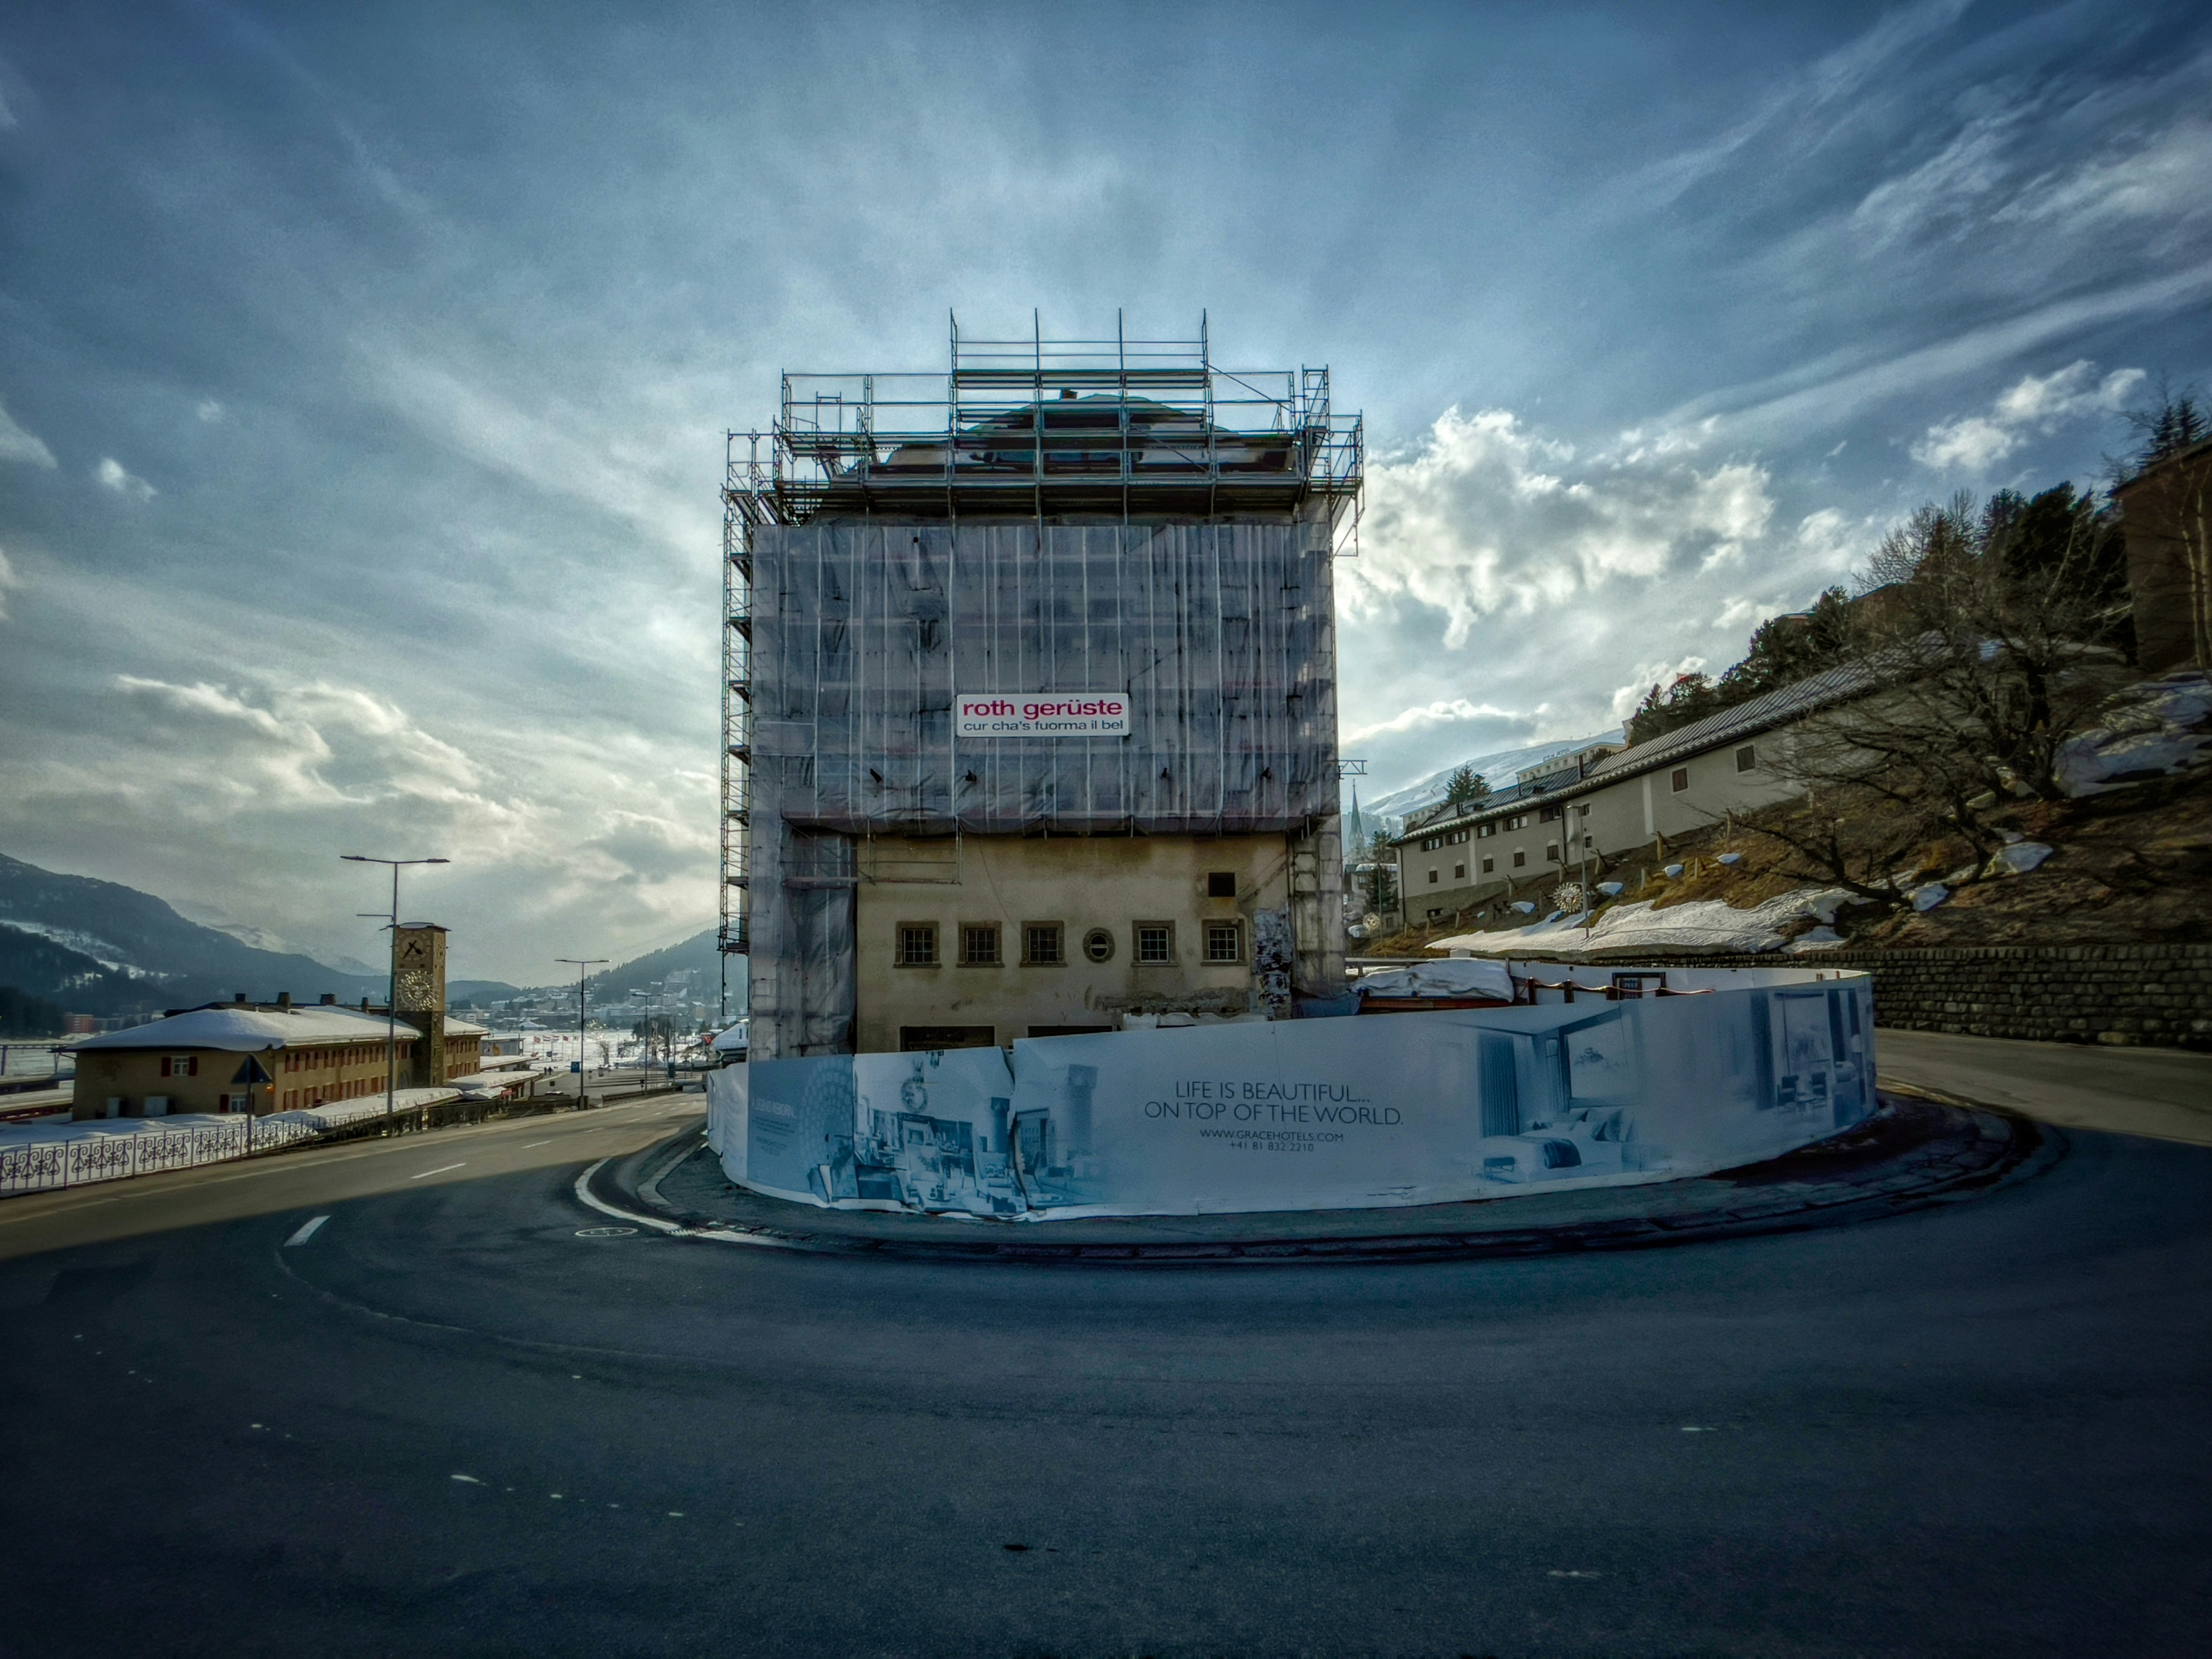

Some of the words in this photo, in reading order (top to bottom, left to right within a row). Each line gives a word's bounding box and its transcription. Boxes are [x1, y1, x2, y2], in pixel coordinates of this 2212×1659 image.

[963, 699, 1014, 716] roth
[1023, 699, 1122, 720] gerüste
[963, 721, 988, 731] cur
[992, 721, 1030, 730] cha's
[1035, 720, 1087, 730] fuorma
[1091, 720, 1097, 730] il
[1102, 720, 1123, 730] bel
[1176, 1081, 1212, 1098] LIFE
[1220, 1082, 1234, 1099] IS
[1243, 1082, 1370, 1102] BEAUTIFUL...
[1145, 1101, 1179, 1118] ON
[1184, 1102, 1226, 1119] TOP
[1234, 1104, 1262, 1120] OF
[1266, 1104, 1309, 1122] THE
[1313, 1105, 1403, 1125] WORLD.
[1200, 1129, 1344, 1142] WWW.GRACEHOTELS.COM
[1230, 1141, 1247, 1149] +41
[1252, 1142, 1262, 1150] 81
[1268, 1142, 1285, 1151] 832
[1290, 1142, 1314, 1152] 2210
